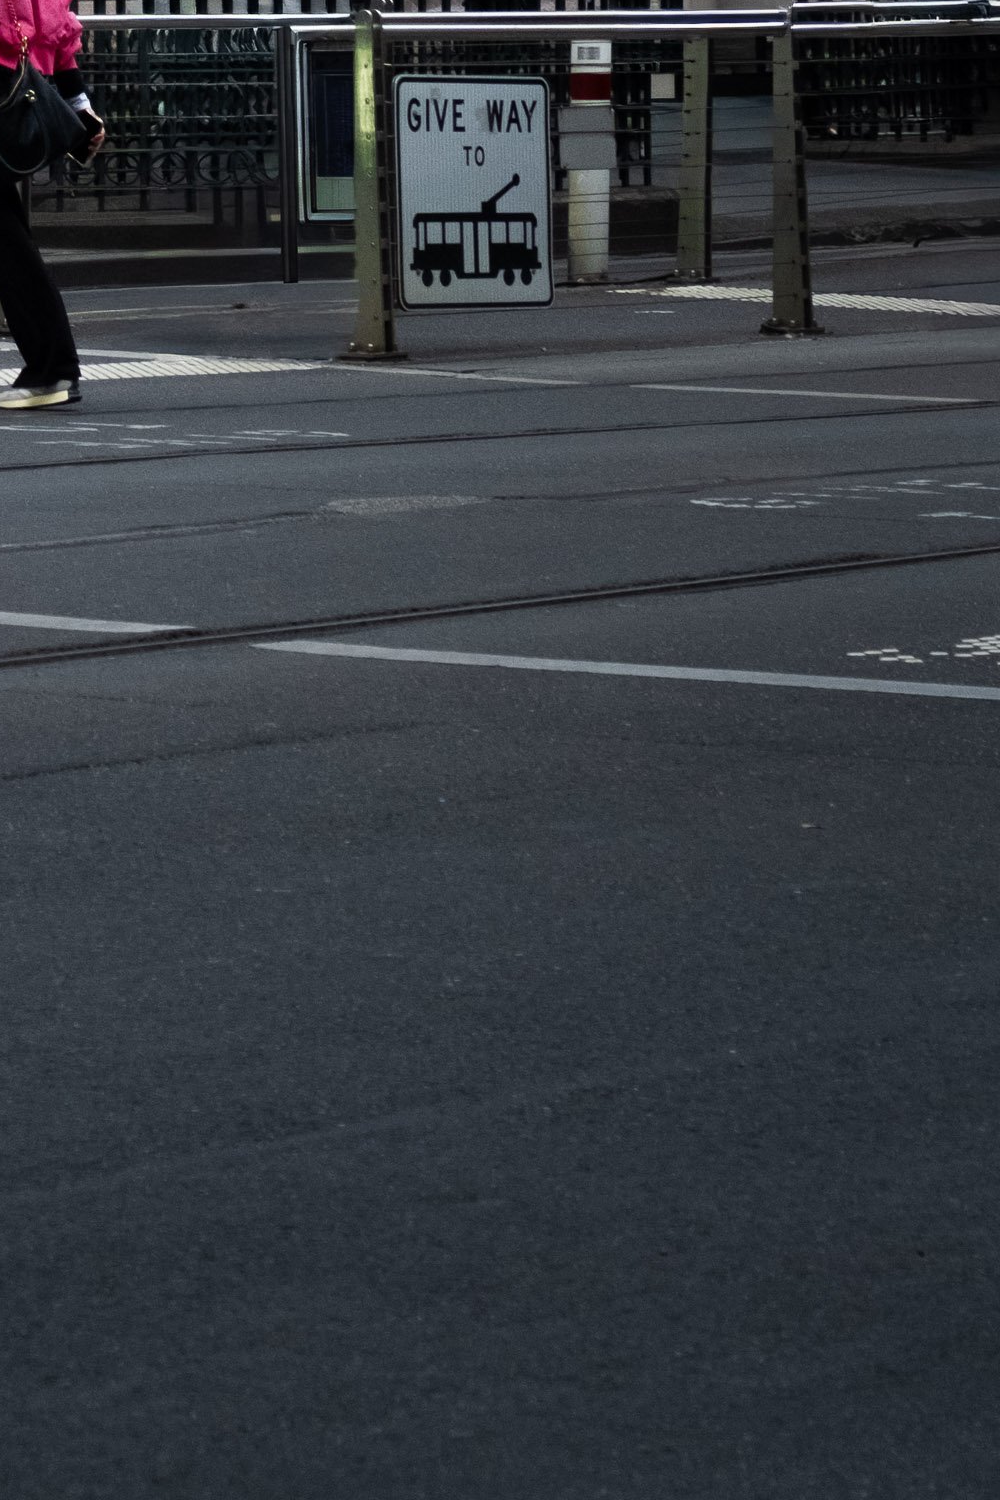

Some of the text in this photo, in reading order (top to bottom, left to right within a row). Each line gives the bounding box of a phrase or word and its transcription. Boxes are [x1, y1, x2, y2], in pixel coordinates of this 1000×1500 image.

[407, 97, 537, 133] GIVE WAY
[462, 145, 486, 167] TO
